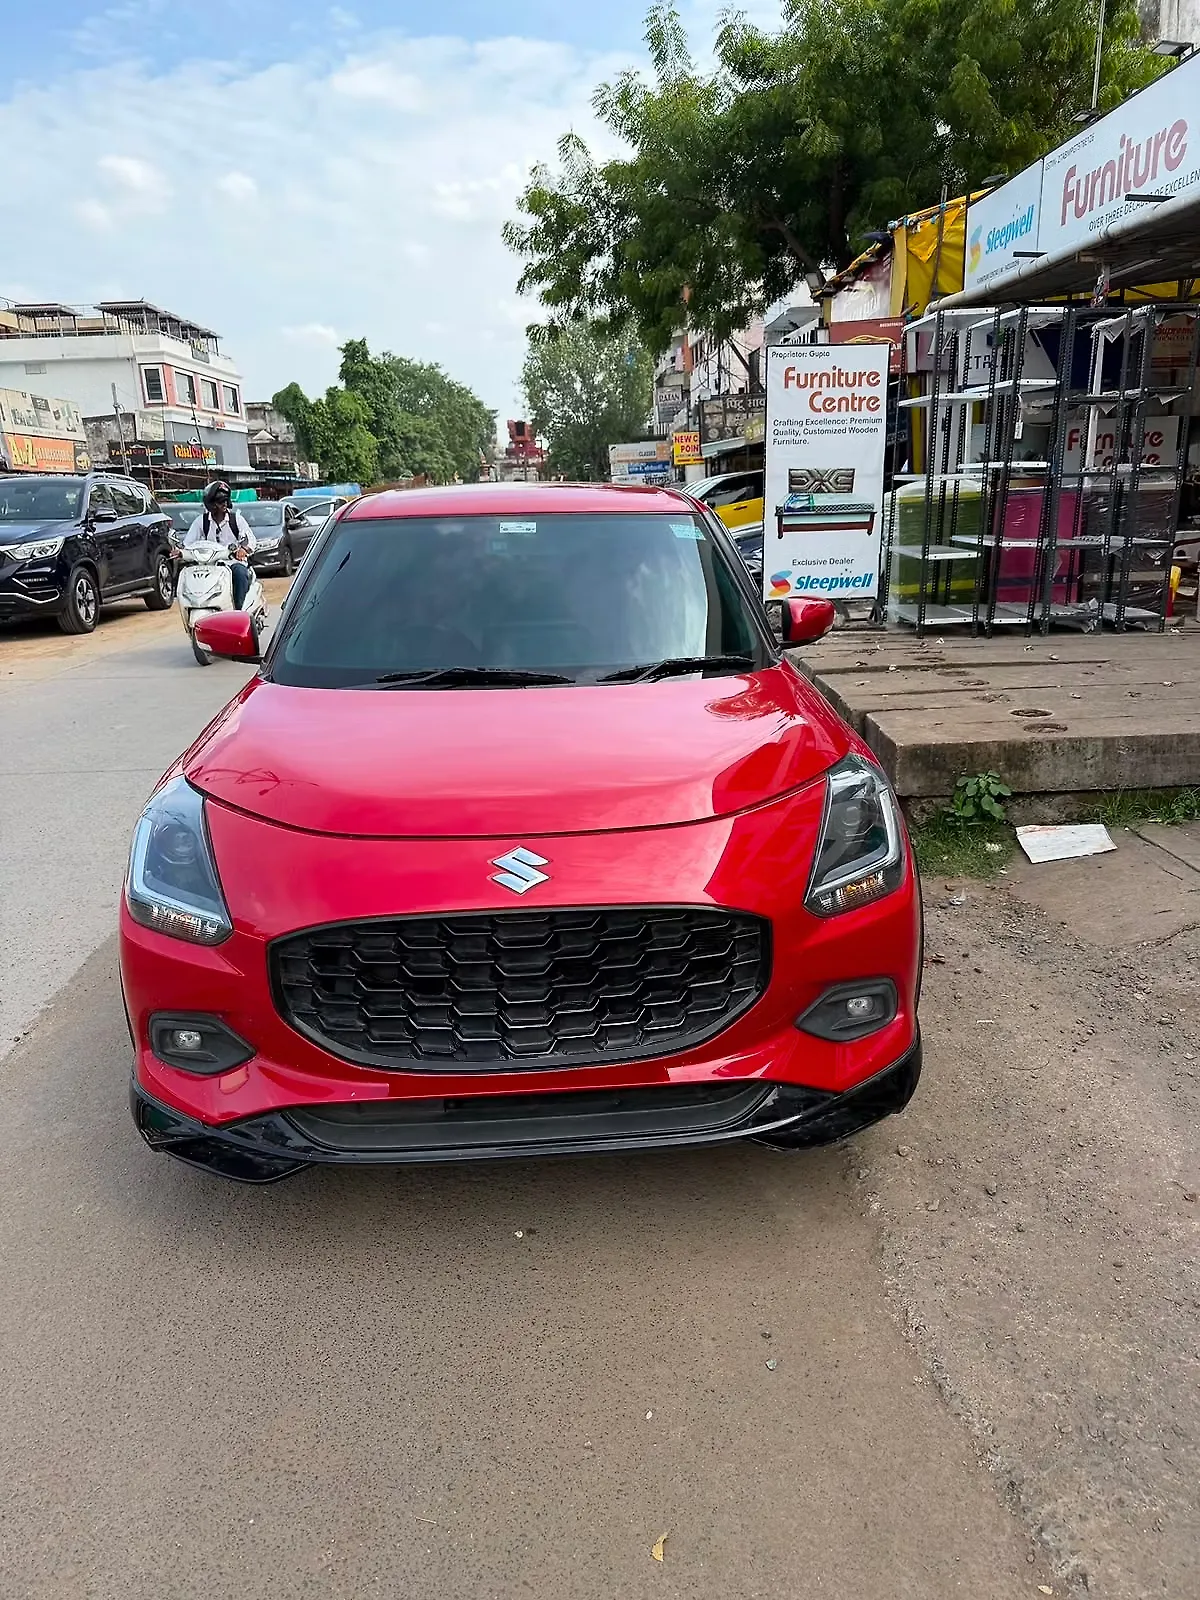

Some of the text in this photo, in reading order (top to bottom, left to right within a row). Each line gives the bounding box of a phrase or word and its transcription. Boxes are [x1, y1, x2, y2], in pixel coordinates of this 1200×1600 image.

[1060, 118, 1188, 227] Furniture
[1088, 215, 1105, 232] OVER
[1104, 206, 1123, 224] THREE
[1164, 168, 1200, 196] EXCELLEN
[985, 204, 1034, 255] Sleepwell
[771, 350, 830, 360] Proprietor: Gupta
[784, 365, 881, 389] Furniture
[808, 390, 881, 413] Centre
[773, 416, 883, 428] Crafting Excellence: Premium
[772, 426, 879, 437] Quality, Customized Wooden
[674, 435, 692, 444] NEW
[772, 437, 810, 446] Furniture.
[680, 444, 699, 453] POIN
[792, 557, 855, 566] Exclusive Dealer
[795, 572, 874, 591] Sleepwell
